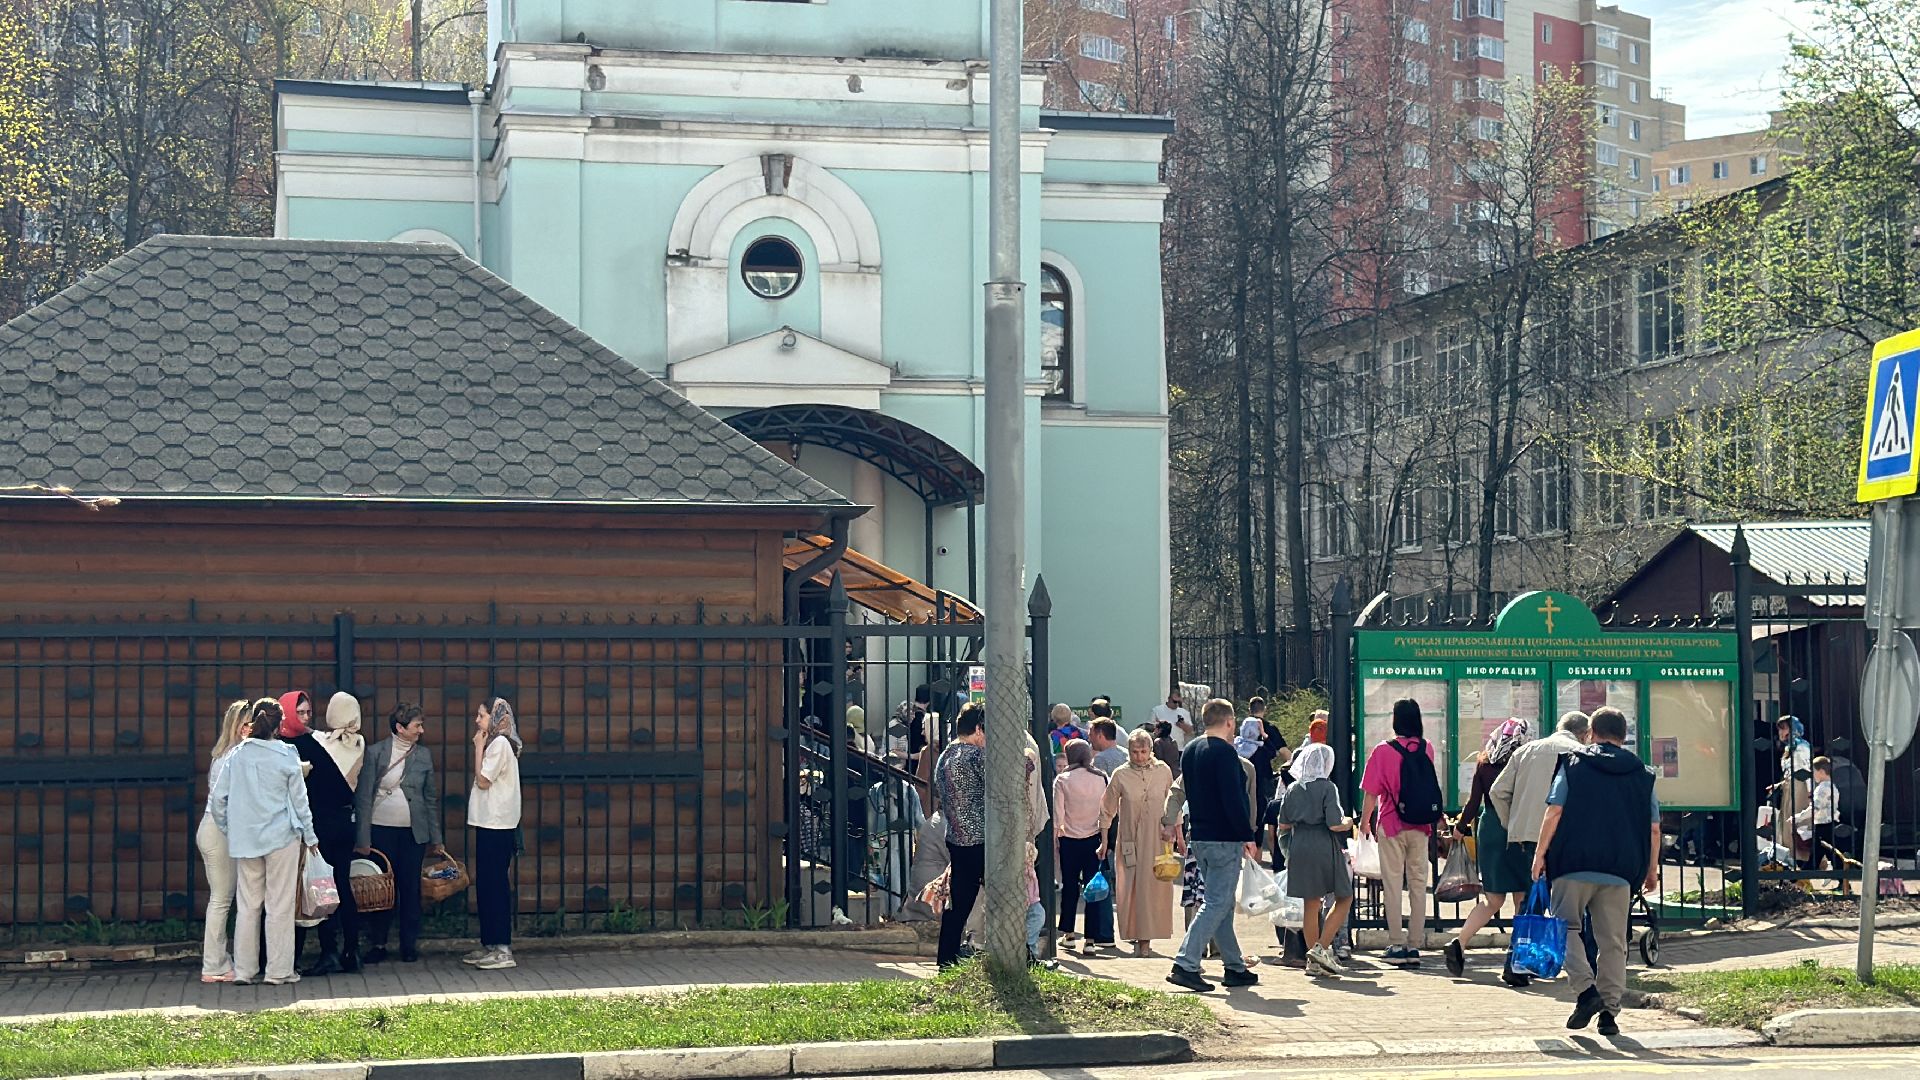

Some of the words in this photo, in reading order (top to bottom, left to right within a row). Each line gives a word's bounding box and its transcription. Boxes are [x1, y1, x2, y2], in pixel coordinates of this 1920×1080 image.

[1394, 637, 1441, 648] РУССКАЯ
[1444, 637, 1525, 647] ПРАВОСЛАВНАЯ
[1643, 649, 1673, 658] ХРАМ
[1373, 667, 1443, 676] ИНФОРМАЦИЯ
[1466, 667, 1537, 676] ИНФОРМАЦИЯ
[1568, 667, 1632, 676] ОБЪЯВЛЕНИЯ
[1660, 668, 1724, 676] ОБЪЯВЛЕНИЯ
